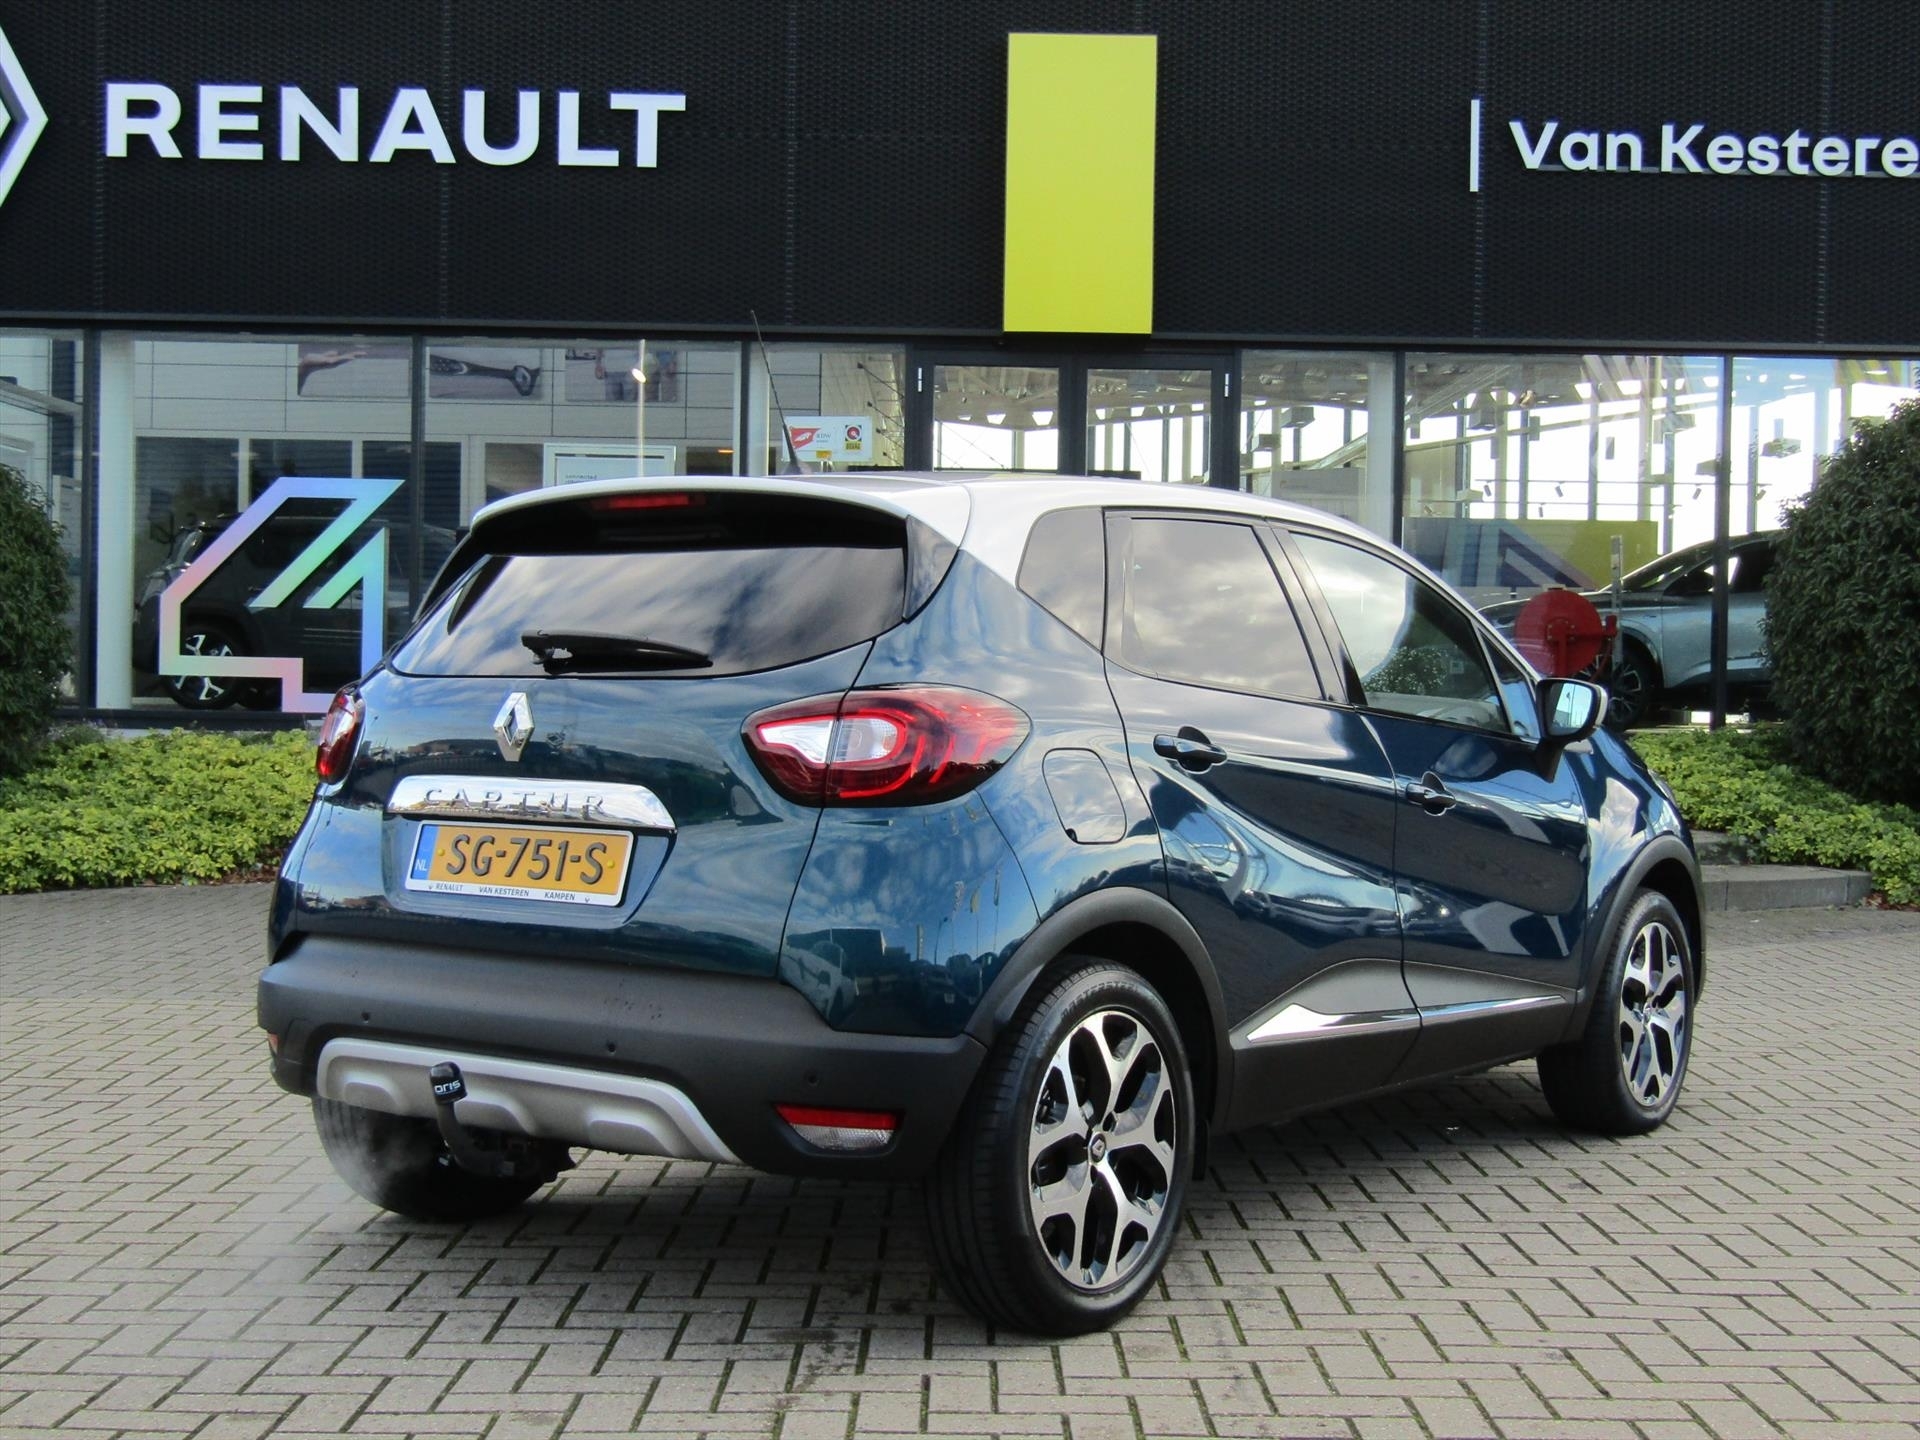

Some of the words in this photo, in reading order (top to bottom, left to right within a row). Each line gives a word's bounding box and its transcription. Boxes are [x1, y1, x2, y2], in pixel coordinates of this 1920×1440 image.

[105, 83, 686, 168] RENAULT
[1508, 120, 1643, 172] Van
[424, 788, 604, 820] CAPTUR
[415, 858, 427, 871] NL
[446, 834, 607, 885] SG-751-S
[435, 882, 464, 892] RENAULT
[479, 886, 494, 895] VAN
[494, 887, 529, 897] KESTEREN
[544, 891, 576, 901] KAMPEN
